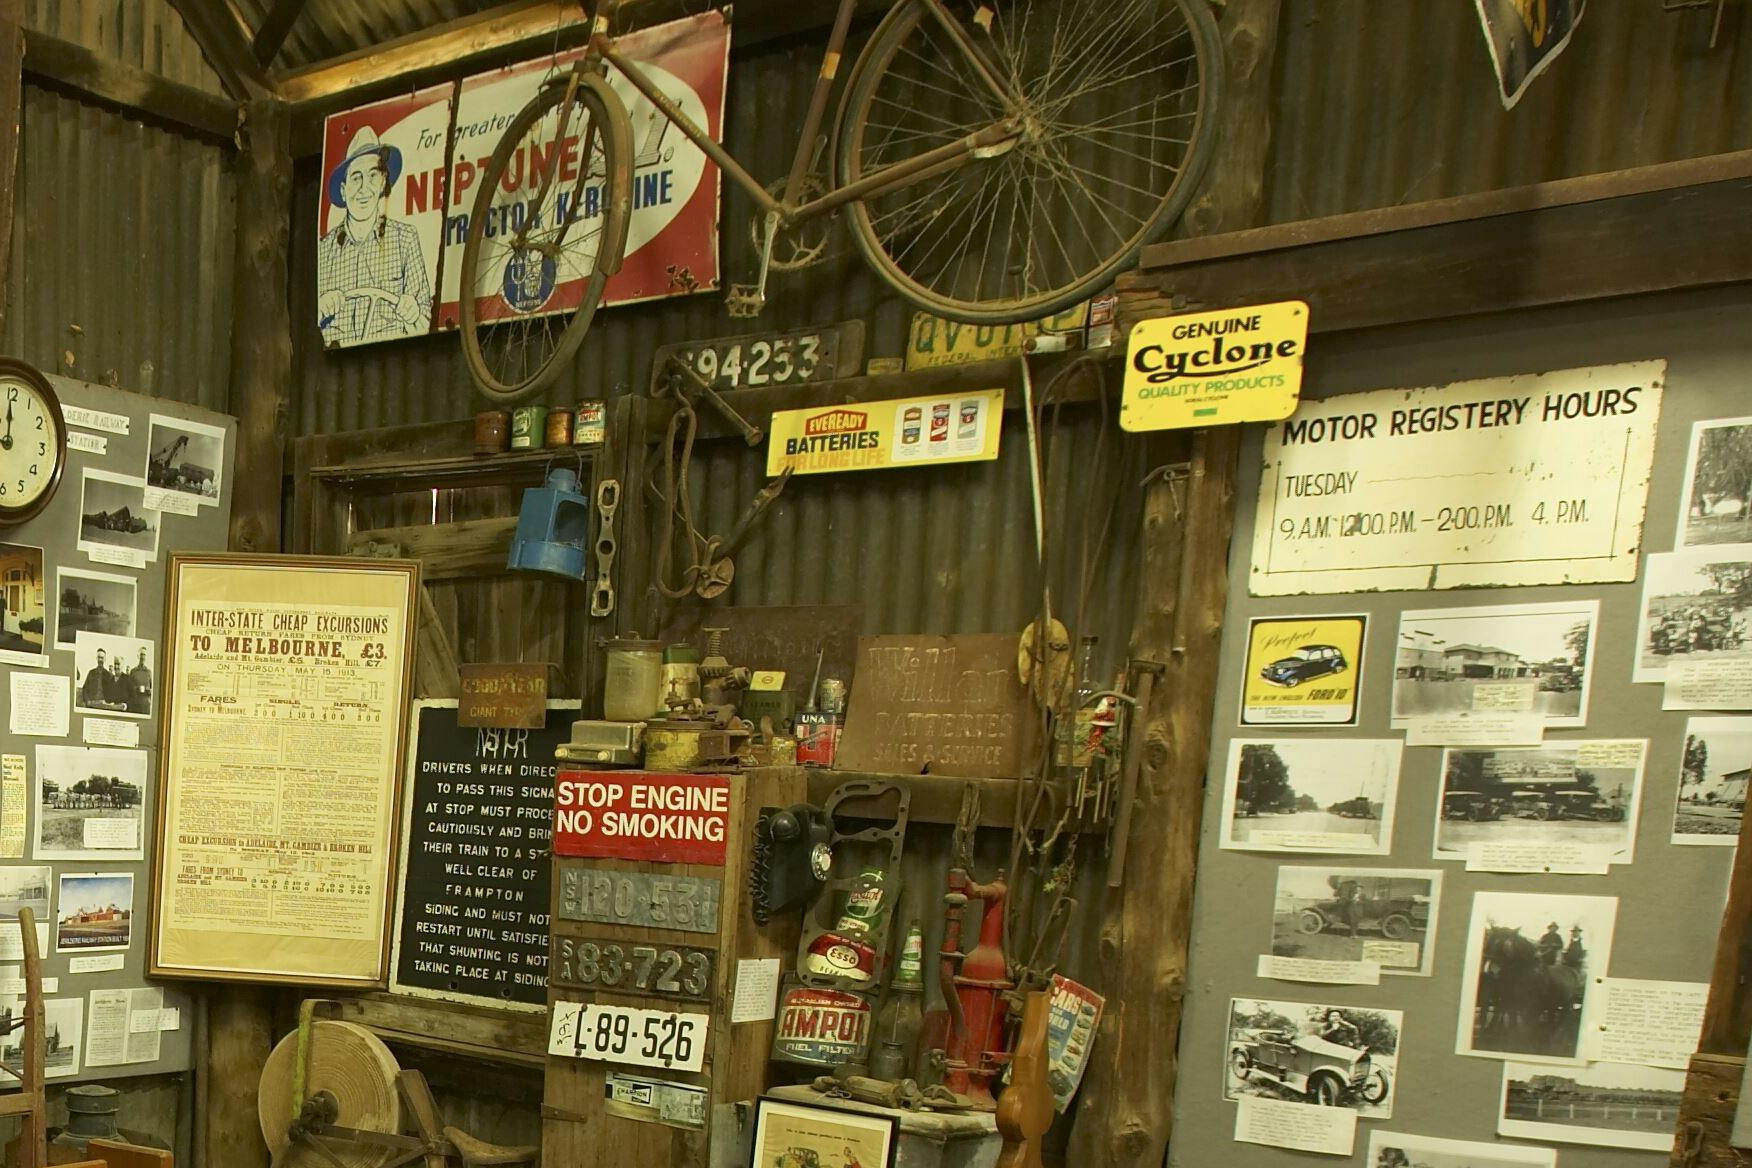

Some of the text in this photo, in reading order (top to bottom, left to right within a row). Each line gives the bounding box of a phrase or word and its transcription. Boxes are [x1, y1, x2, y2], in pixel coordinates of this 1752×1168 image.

[416, 111, 518, 151] For greater
[1172, 315, 1262, 340] GENUINE
[1134, 337, 1298, 383] Cyclone
[7, 387, 19, 402] 12
[1138, 374, 1285, 400] QUALITY PRODUCTS
[35, 416, 44, 430] 2
[809, 413, 865, 432] EVEREADY
[1281, 386, 1643, 447] MOTOR REGISTERY HOURS
[38, 442, 46, 456] 3
[786, 431, 880, 455] BATTERIES
[811, 452, 852, 470] LONG
[853, 448, 886, 466] LIFE
[29, 464, 38, 475] 4
[0, 483, 7, 495] 6
[17, 480, 25, 493] 5
[1284, 471, 1359, 499] TUESDAY
[273, 613, 308, 631] CHEAP
[317, 616, 389, 635] EXCURSIONS
[190, 635, 211, 651] TO
[1263, 627, 1317, 651] Prefect
[217, 663, 231, 671] ON
[237, 664, 286, 673] THURSDAY
[200, 695, 237, 705] FARES
[470, 706, 498, 718] GIANT
[802, 714, 826, 724] UNA
[422, 761, 513, 776] DRIVERS WHEN
[437, 782, 514, 797] TO PASS THIS
[557, 781, 729, 813] STOP ENGINE
[425, 802, 511, 818] AT STOP MUST
[428, 822, 522, 838] CAUTIOUSLY AND
[557, 809, 725, 843] NO SMOKING
[423, 841, 453, 855] THEIR
[458, 843, 489, 856] TRAIN
[495, 846, 509, 858] TO
[445, 863, 538, 881] WELL CLEAR OF
[445, 884, 524, 902] FRAMPTON
[425, 903, 551, 926] SIDING AND MUST NOT
[416, 921, 462, 937] RESTART
[467, 927, 497, 941] UNTIL
[419, 941, 549, 967] THAT SHUNTING IS NOT
[414, 959, 550, 988] TAKING PLACE AT SIDING
[785, 1043, 856, 1055] FUEL FILTER
